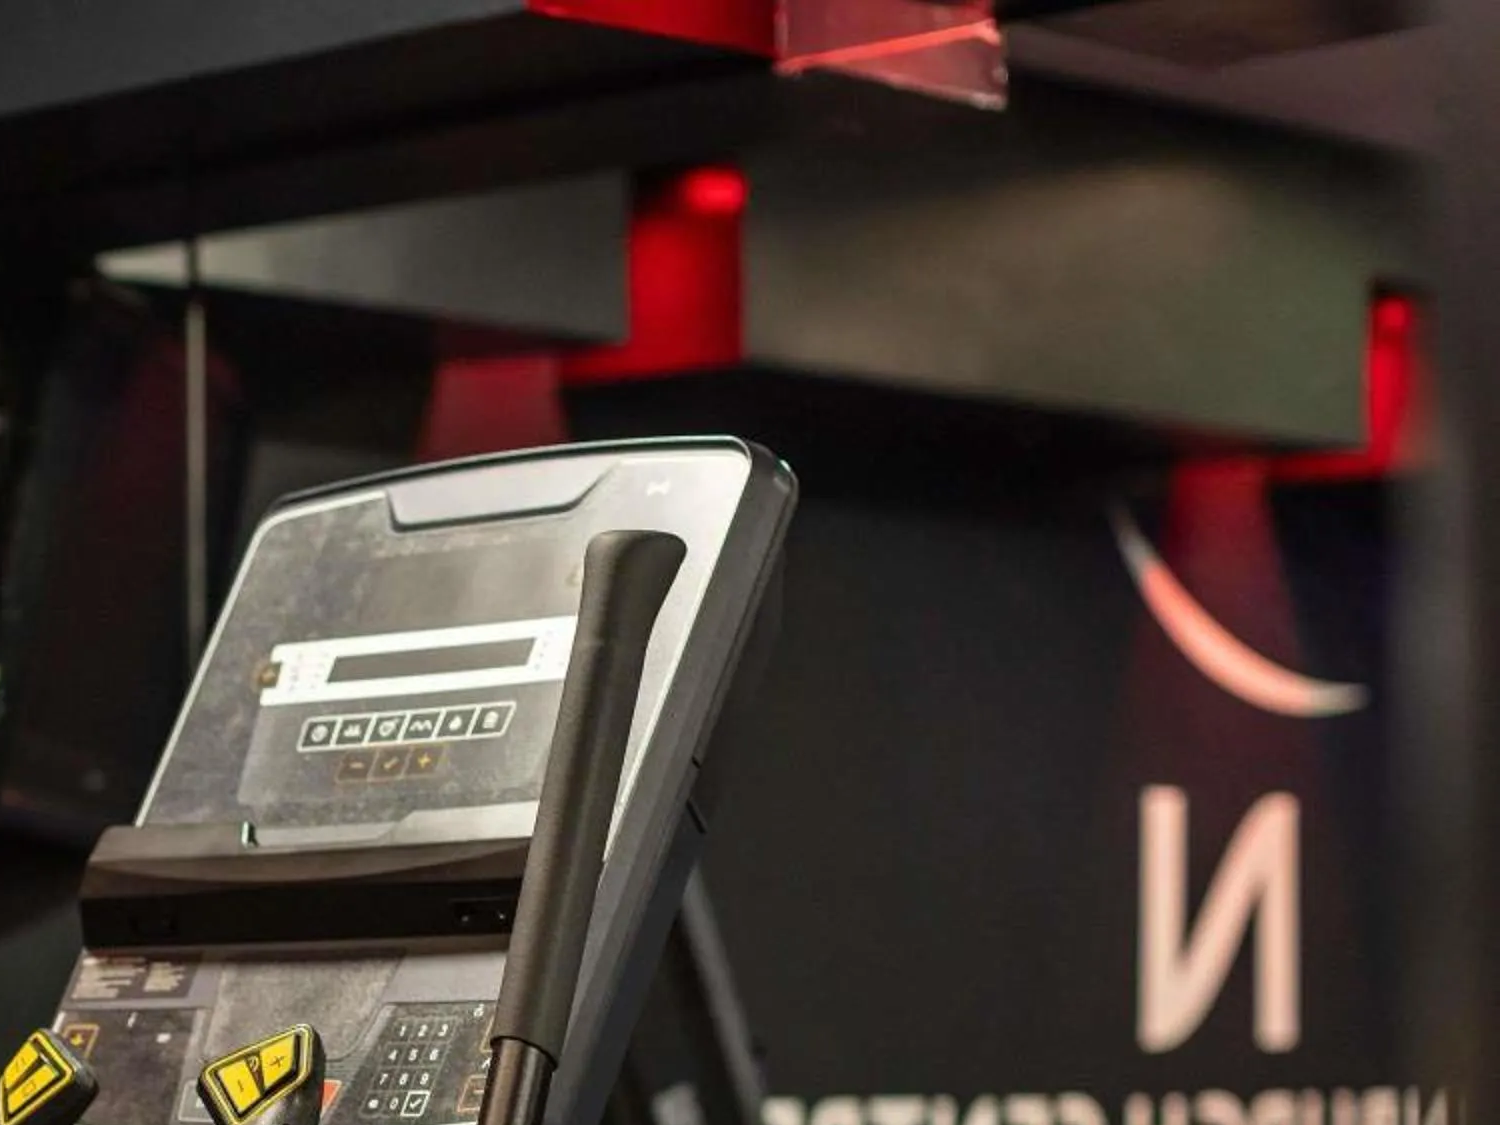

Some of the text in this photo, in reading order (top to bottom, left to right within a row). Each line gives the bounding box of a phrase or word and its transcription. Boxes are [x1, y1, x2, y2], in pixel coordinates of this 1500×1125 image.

[399, 1023, 449, 1037] 1 2 3
[387, 1049, 440, 1061] 4 5 6
[379, 1072, 430, 1086] 7 8 9
[389, 1097, 399, 1110] 0
